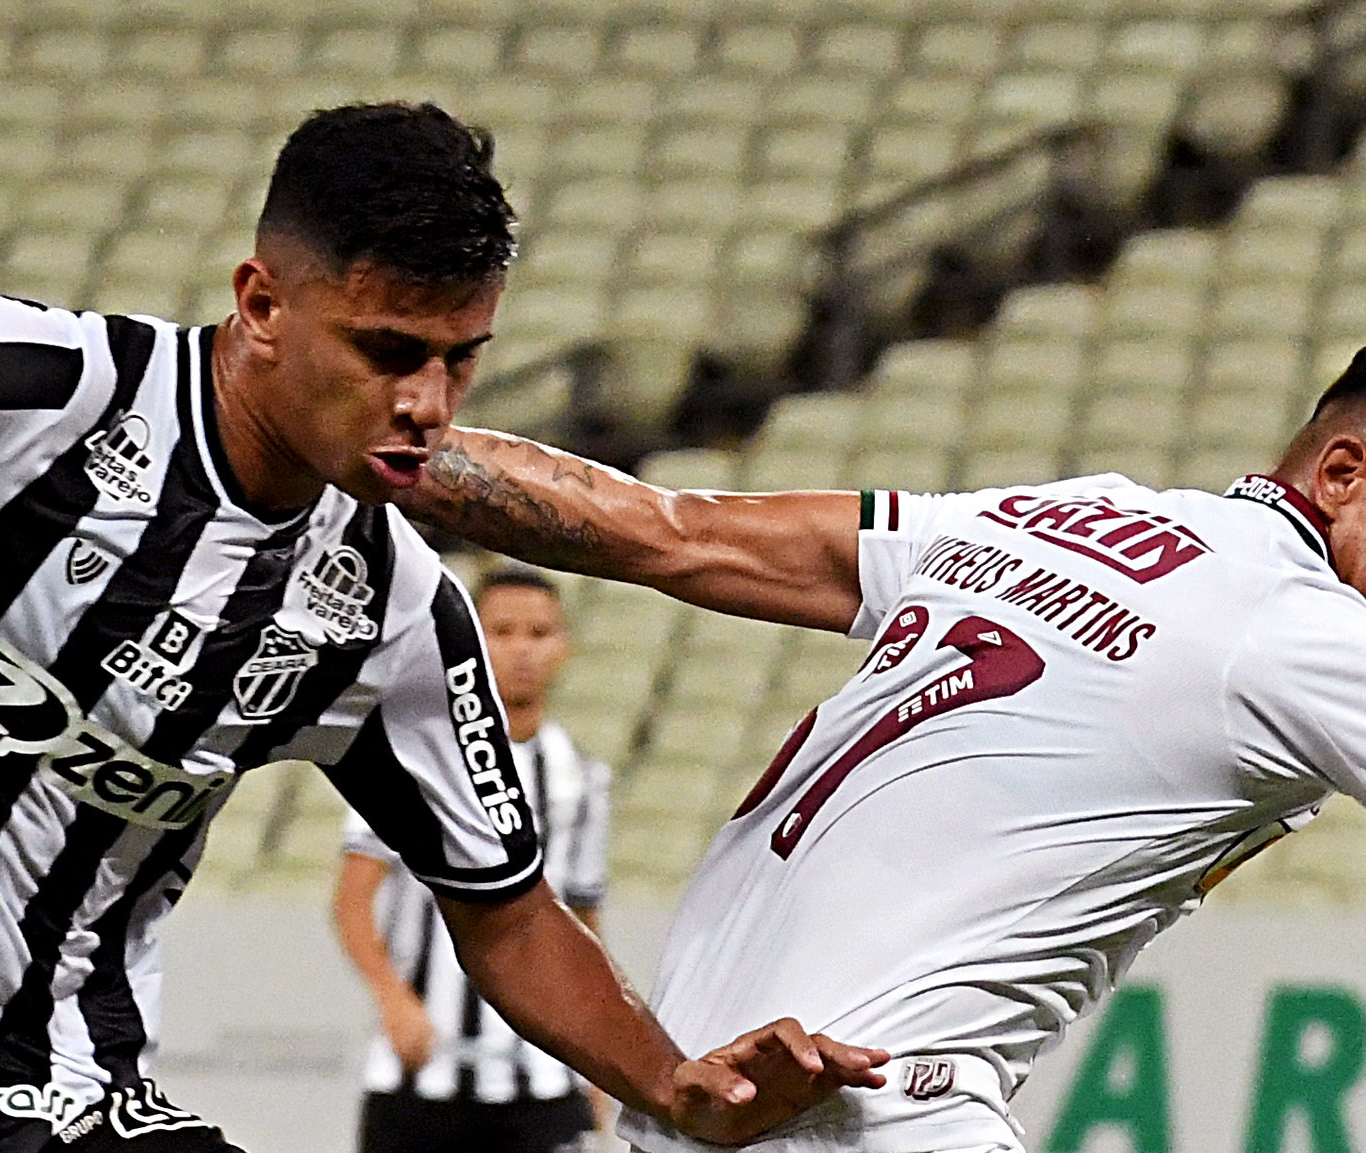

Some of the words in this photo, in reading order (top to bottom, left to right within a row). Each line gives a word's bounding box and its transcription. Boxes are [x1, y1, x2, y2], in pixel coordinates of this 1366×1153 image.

[995, 568, 1157, 661] MARTINS
[924, 669, 974, 706] TIM
[446, 657, 522, 836] betcris
